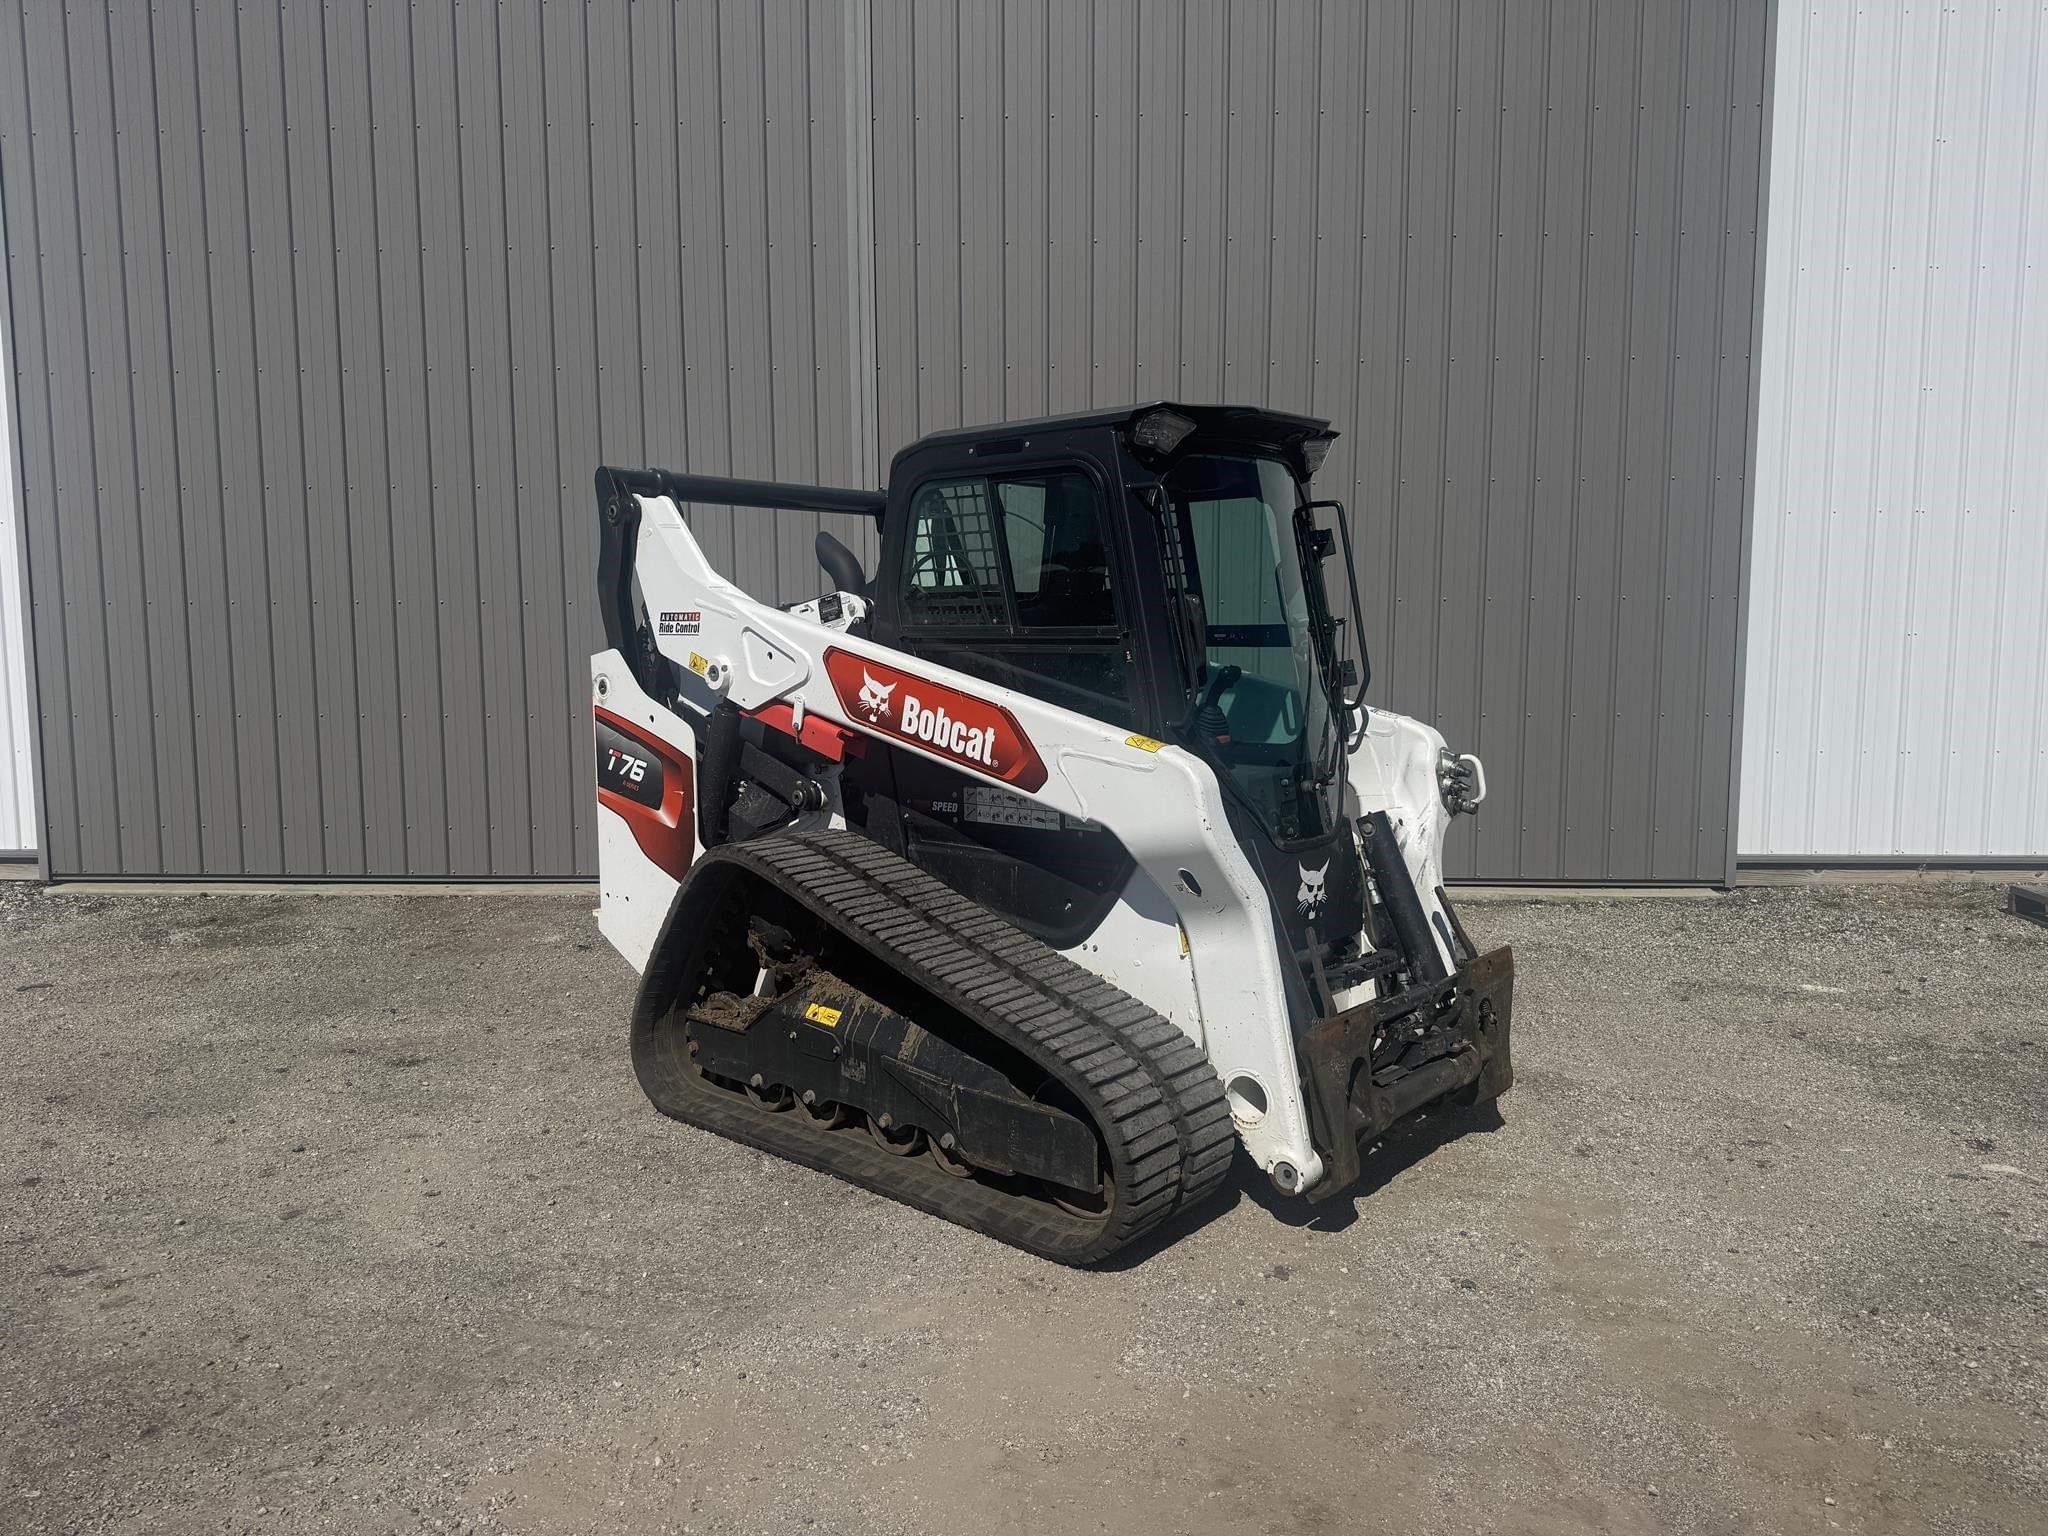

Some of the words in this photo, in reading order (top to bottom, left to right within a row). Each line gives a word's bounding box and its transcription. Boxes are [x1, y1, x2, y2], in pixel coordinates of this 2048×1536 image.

[660, 612, 700, 621] AUTOMATIC
[659, 622, 673, 633] Ride
[675, 622, 700, 633] Control
[901, 694, 995, 766] Bobcat
[608, 748, 648, 782] T76
[931, 801, 958, 813] SPEED
